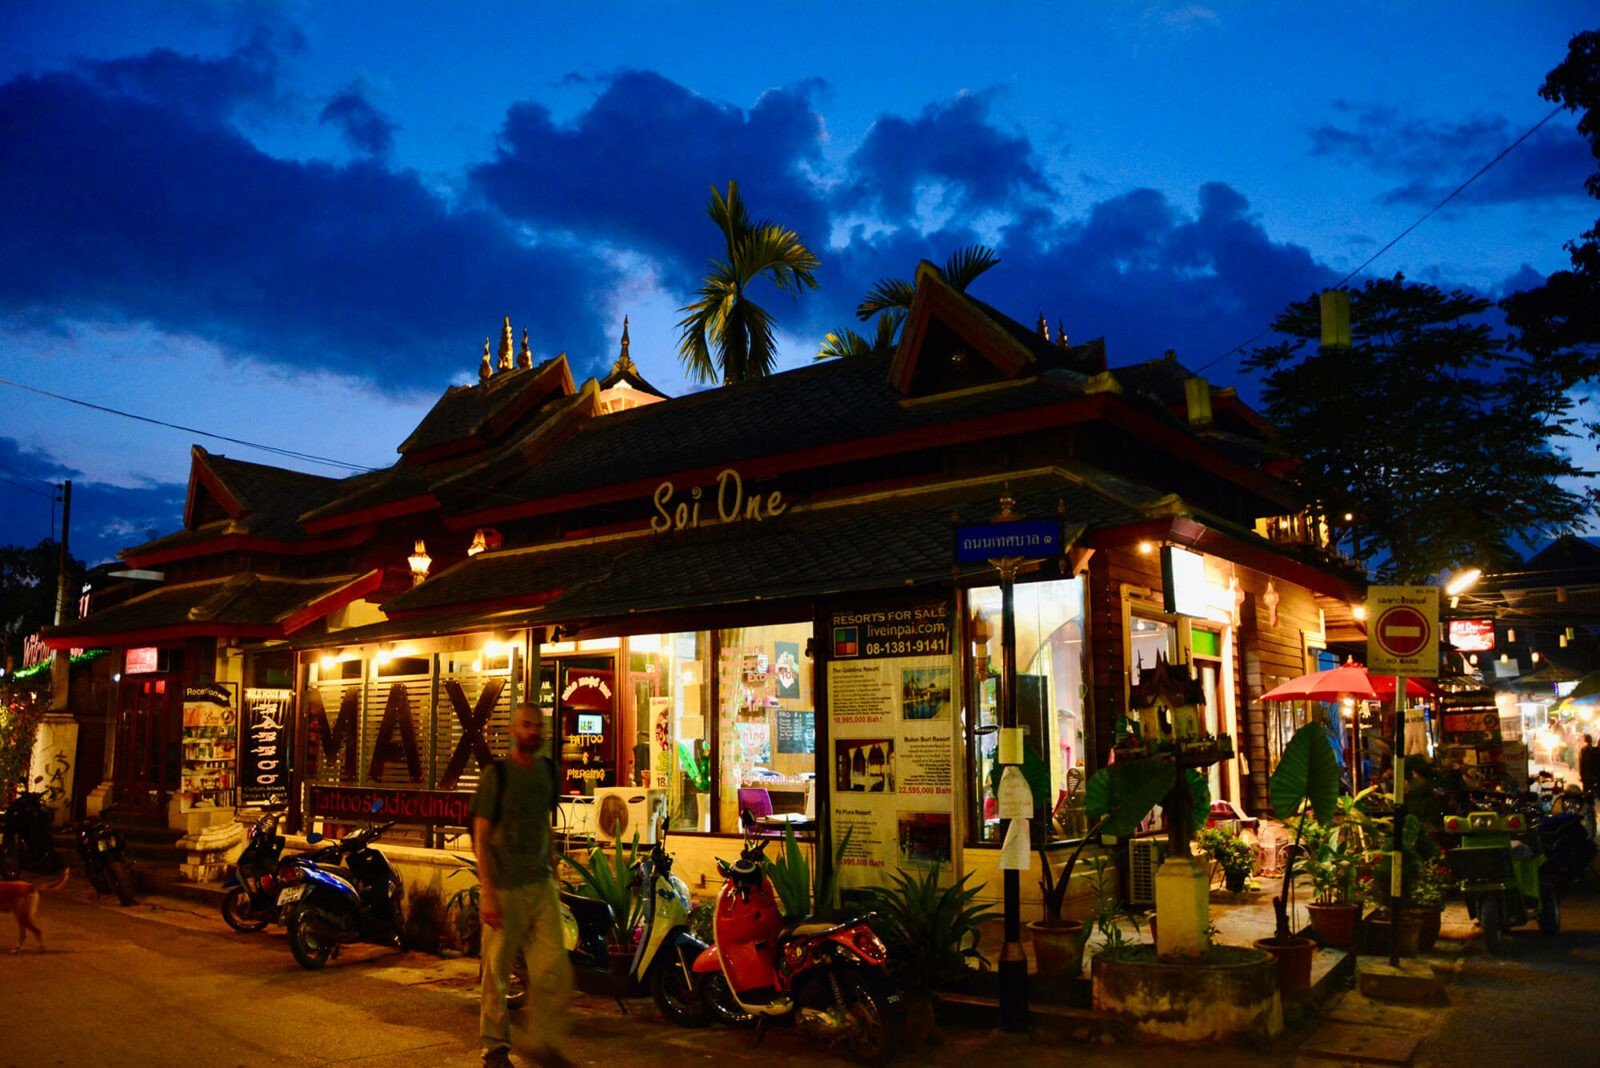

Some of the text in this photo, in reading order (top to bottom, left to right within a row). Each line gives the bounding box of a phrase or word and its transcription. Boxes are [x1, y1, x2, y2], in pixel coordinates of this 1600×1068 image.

[650, 468, 787, 534] Soi One
[963, 533, 1040, 551] ถนนเทศบาล
[832, 607, 947, 626] RESORTS FOR SALE
[866, 621, 946, 639] liveinpai.com
[866, 637, 945, 656] 08-1381-9141
[308, 678, 507, 790] MAX
